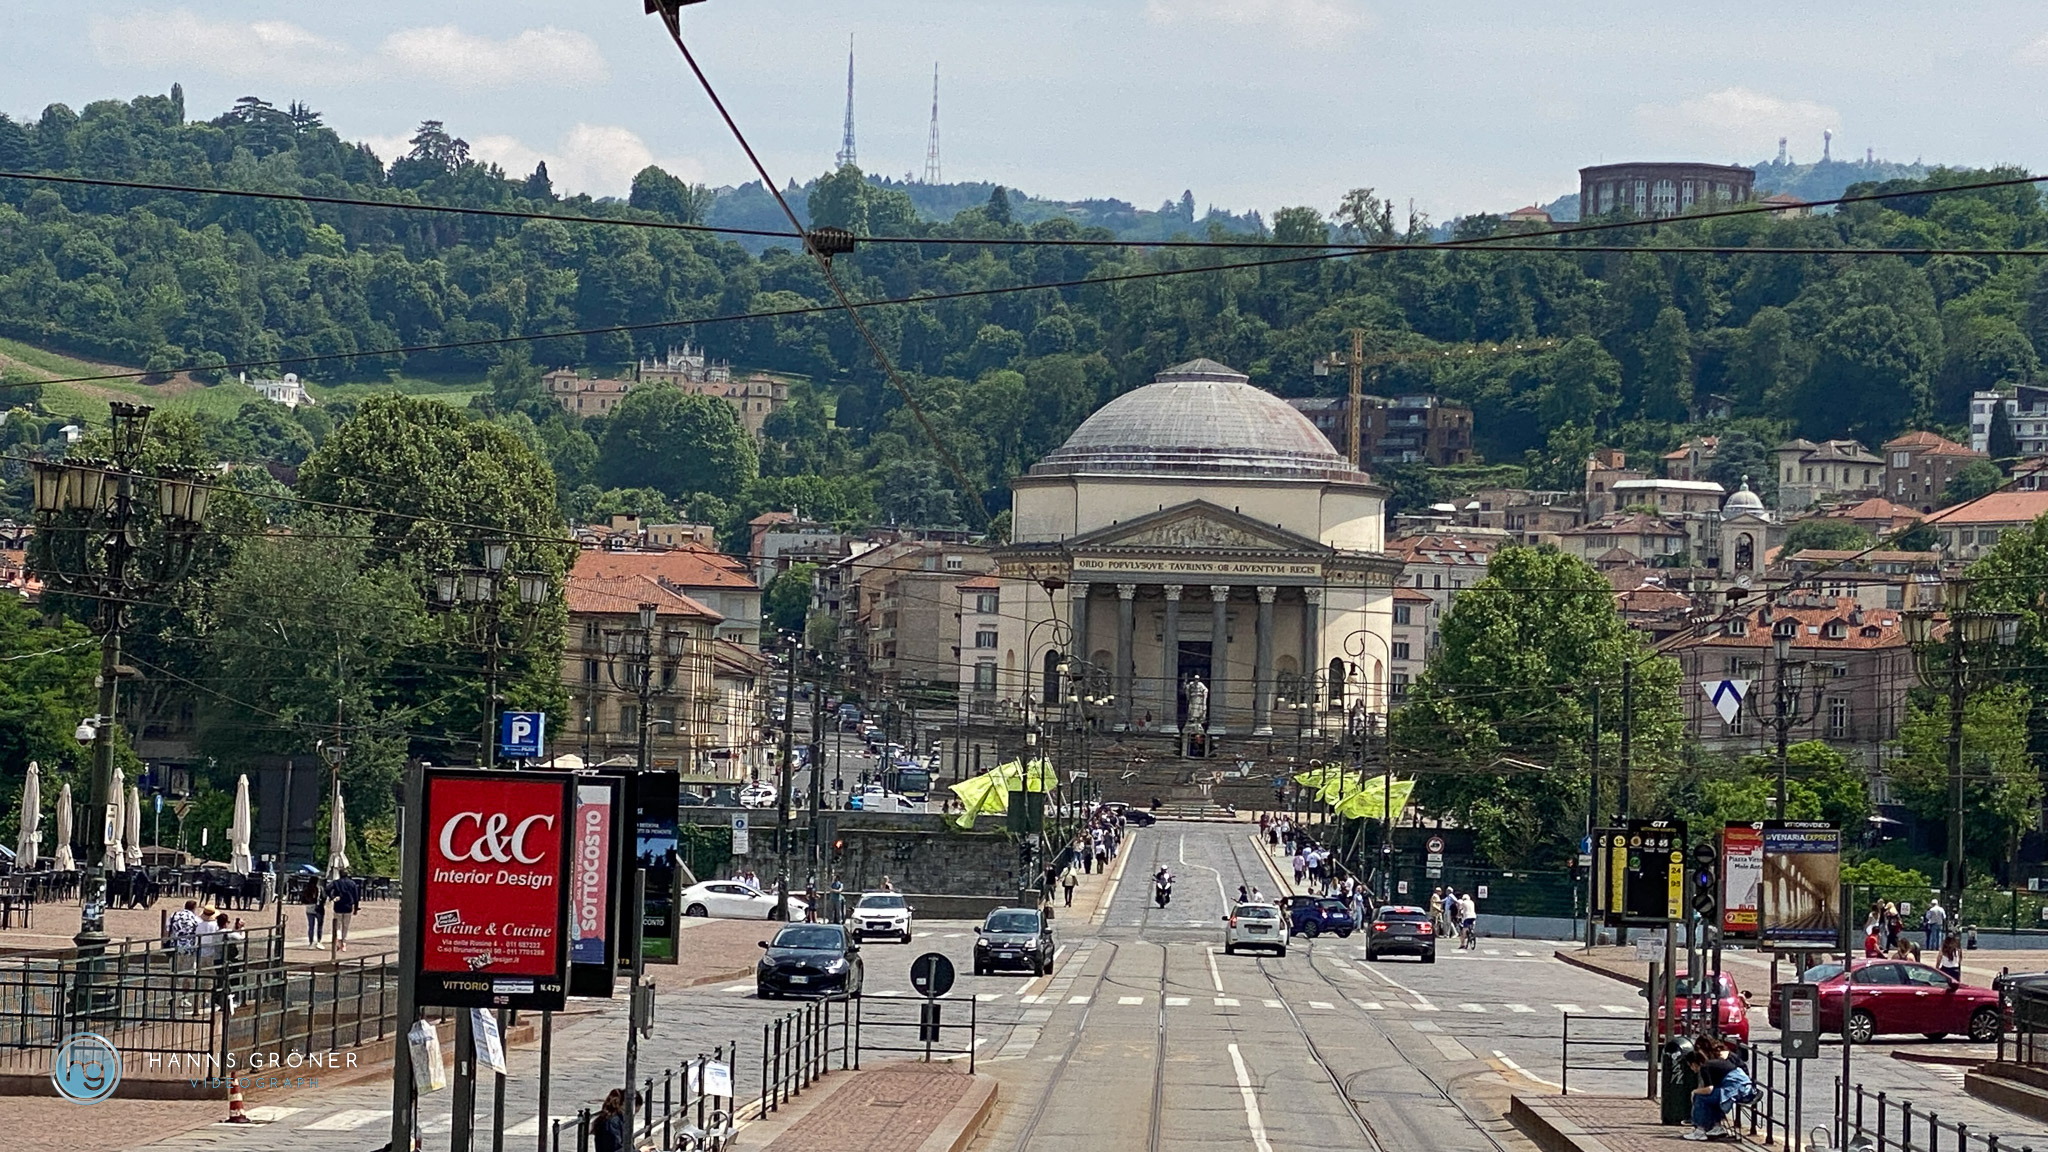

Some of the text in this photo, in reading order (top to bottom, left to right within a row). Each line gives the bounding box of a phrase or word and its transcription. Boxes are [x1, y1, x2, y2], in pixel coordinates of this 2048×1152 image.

[1108, 561, 1164, 570] POPVLVSQVE
[1168, 563, 1213, 571] TAVRINVS
[1232, 564, 1285, 573] ADVENTVM
[1289, 565, 1315, 574] REGIS
[511, 721, 531, 744] P
[439, 811, 555, 864] C&C
[433, 868, 553, 890] Interior Design
[581, 810, 602, 931] SOTTOCOSTO
[432, 921, 552, 938] Cucine & Cucine
[443, 980, 489, 991] VITTORIO
[540, 984, 561, 992] N.479
